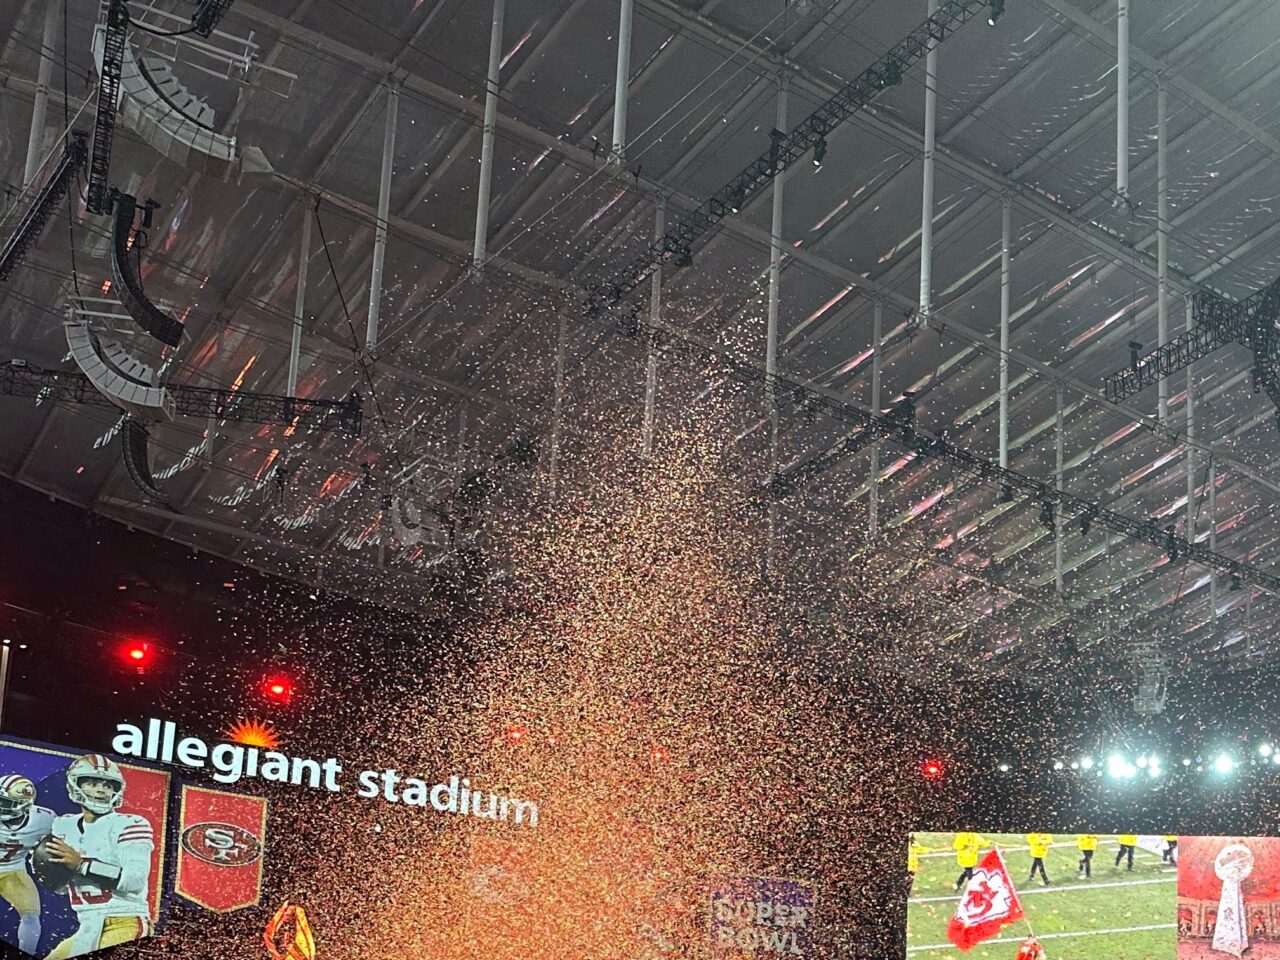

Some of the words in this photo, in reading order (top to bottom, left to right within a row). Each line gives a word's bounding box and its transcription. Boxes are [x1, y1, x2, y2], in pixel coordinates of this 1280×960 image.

[112, 718, 341, 792] allegiant
[359, 768, 539, 827] stadium
[716, 899, 808, 928] SUPER
[719, 928, 805, 955] BOWL
